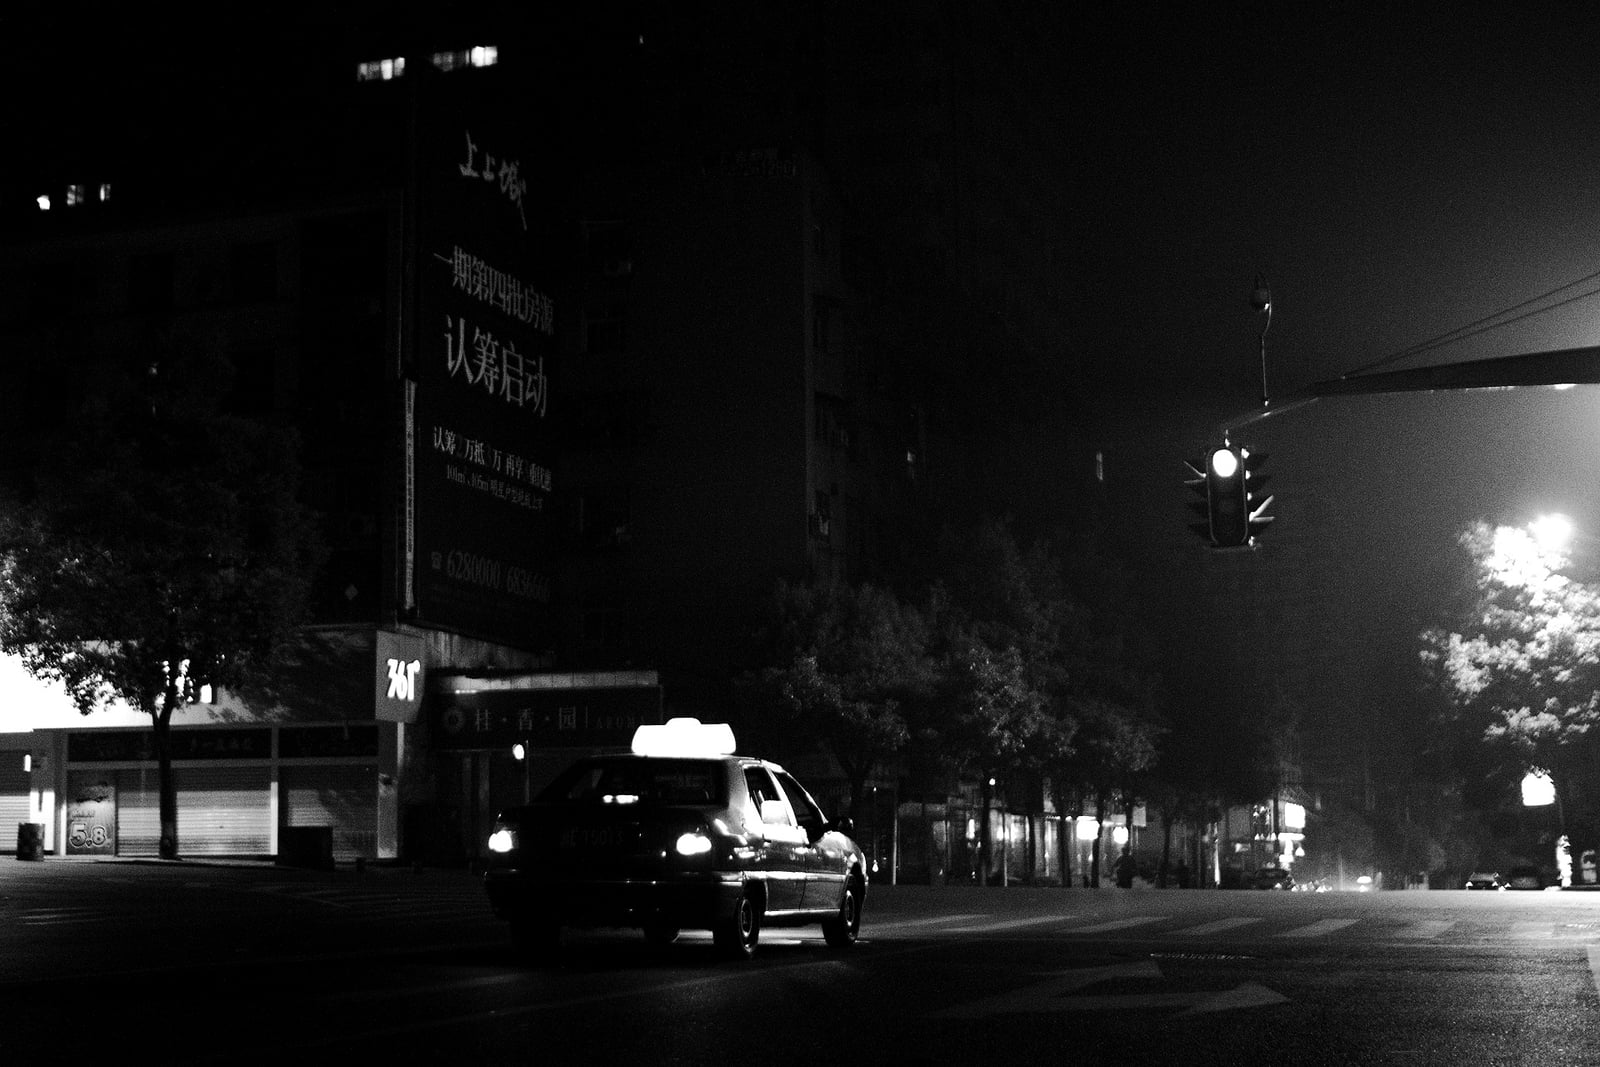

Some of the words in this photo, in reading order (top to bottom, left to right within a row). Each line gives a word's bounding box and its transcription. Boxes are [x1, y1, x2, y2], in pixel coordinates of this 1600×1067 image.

[433, 244, 554, 336] 一期第四批房源
[444, 314, 548, 418] 认筹启动
